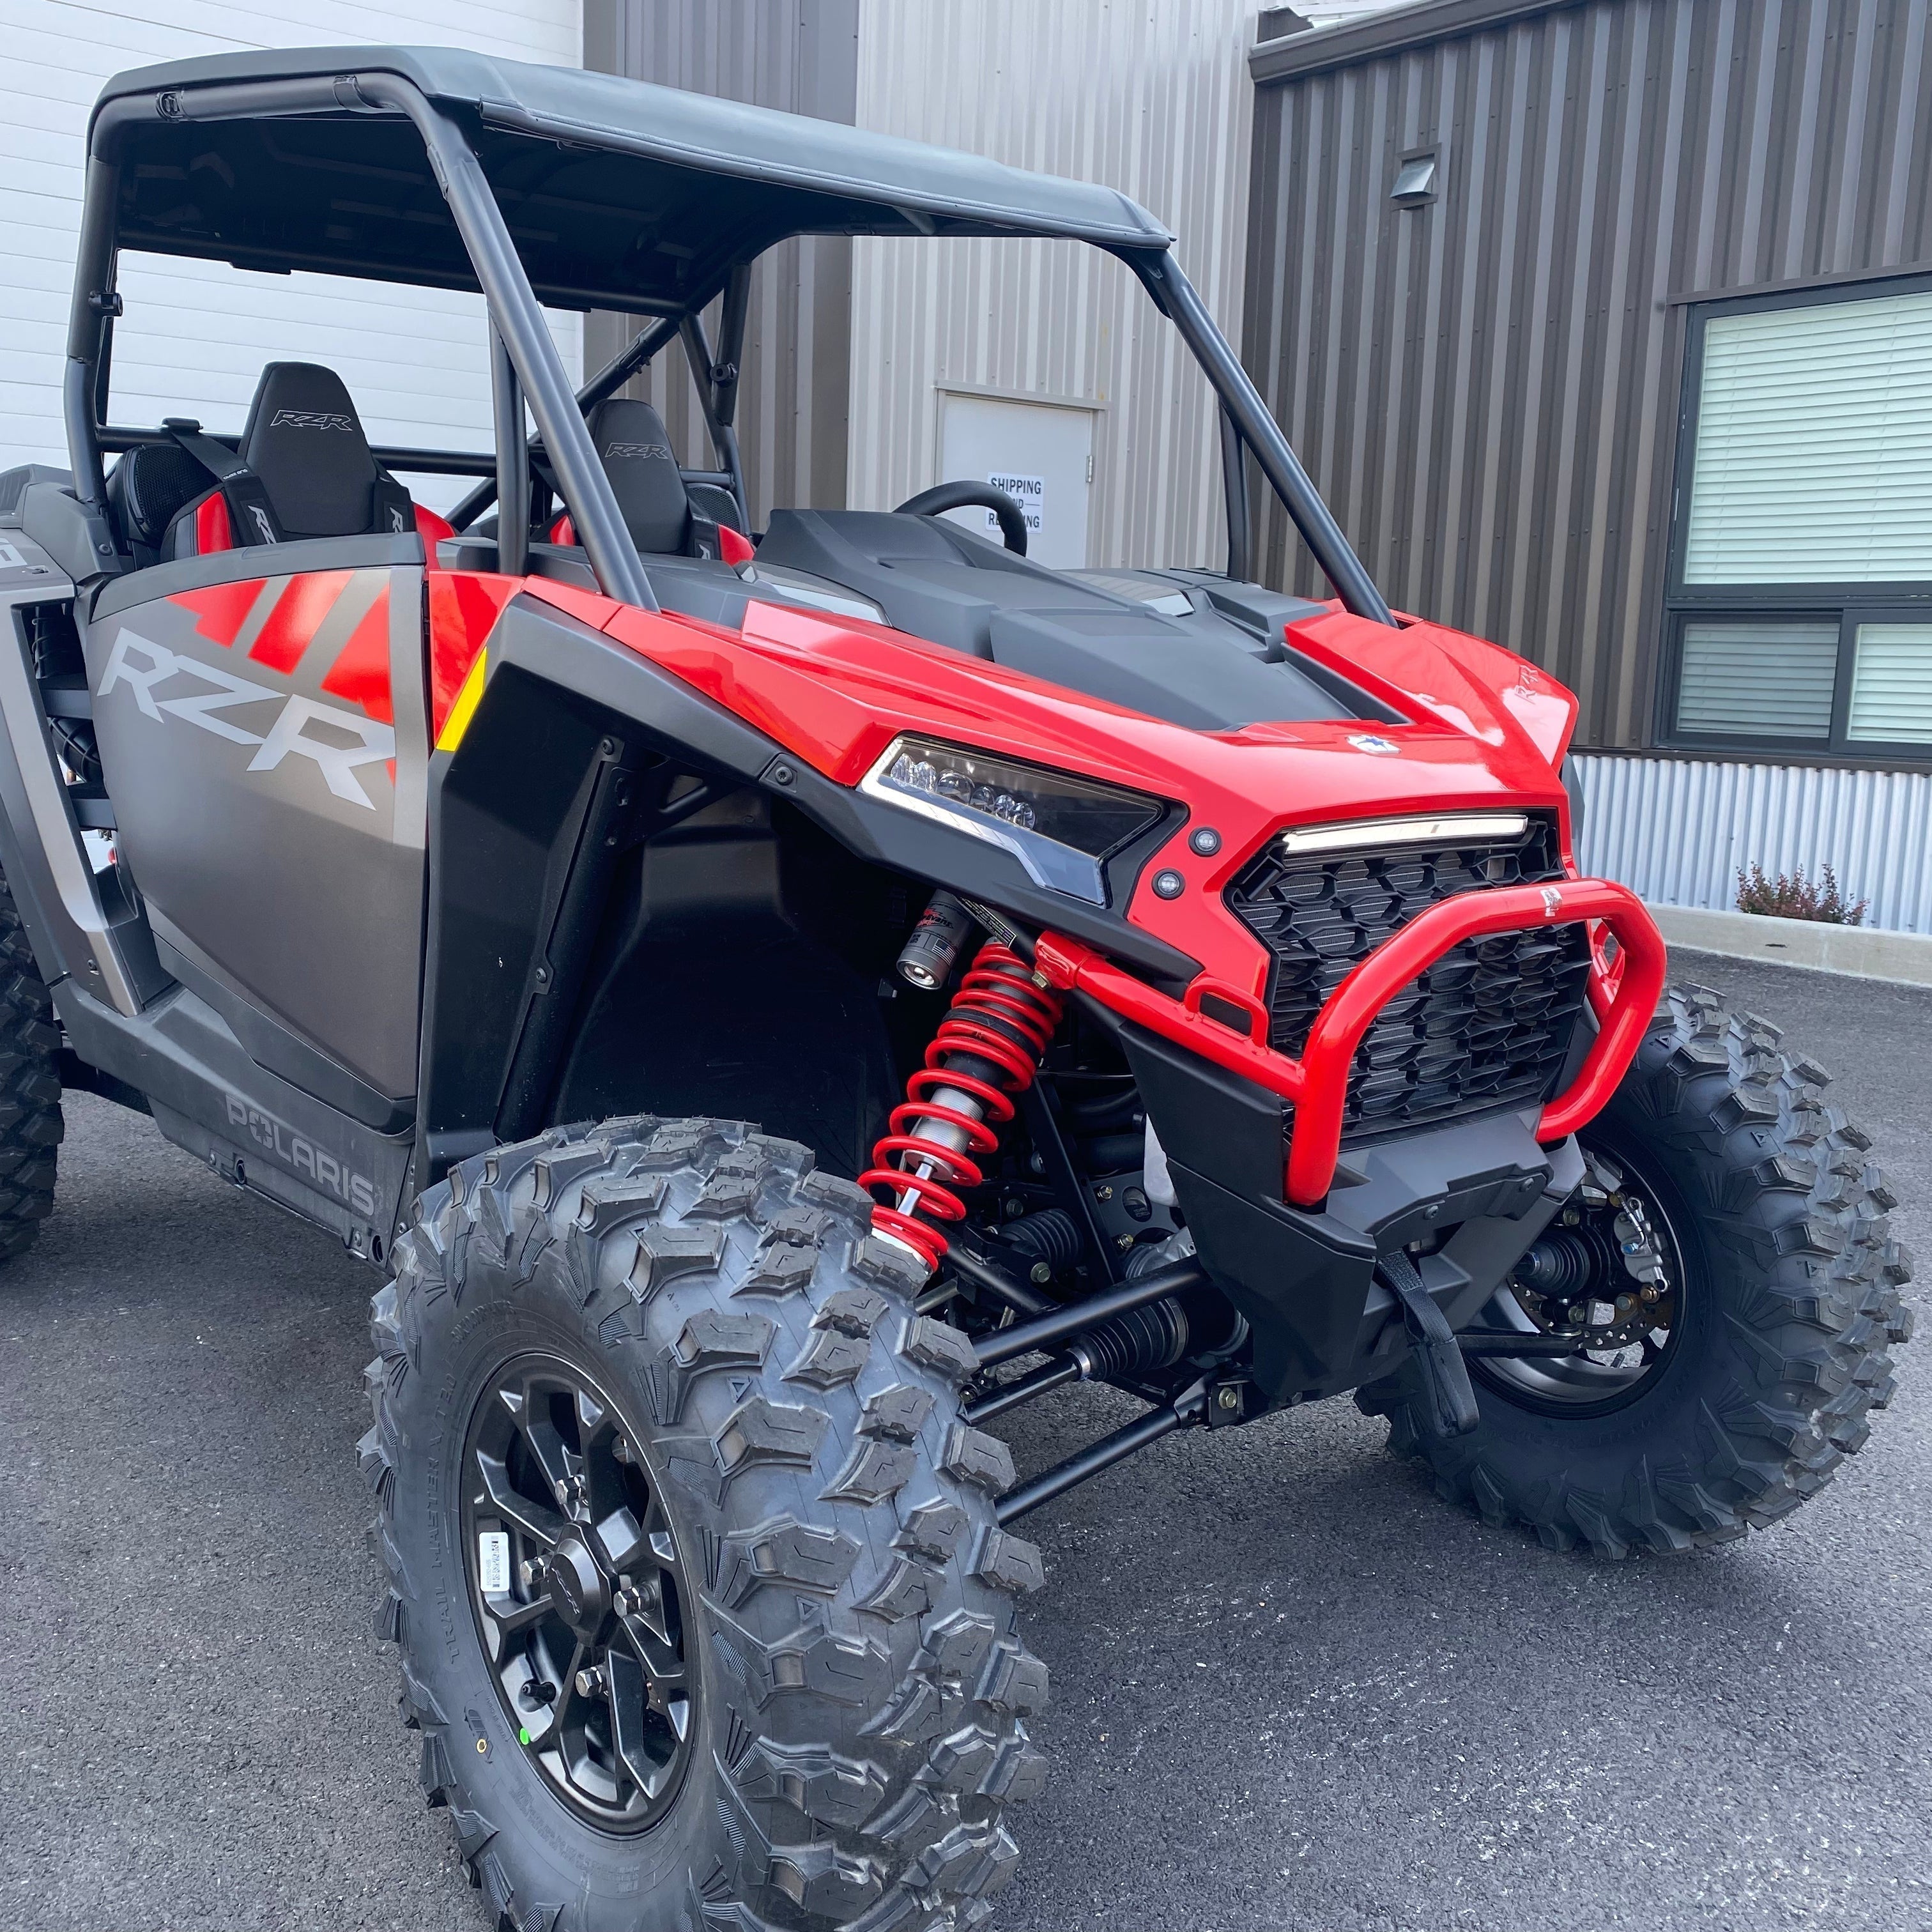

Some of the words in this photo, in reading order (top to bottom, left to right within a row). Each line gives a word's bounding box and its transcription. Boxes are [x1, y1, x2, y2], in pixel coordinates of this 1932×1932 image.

[271, 409, 353, 431] RZR
[605, 442, 668, 459] RZR
[991, 477, 1041, 494] SHIPPING
[1013, 498, 1023, 509] ND
[248, 505, 277, 544] RZ
[97, 627, 395, 811] RZR
[226, 1094, 374, 1216] POLARIS
[427, 1457, 442, 1568] MASTER
[434, 1577, 459, 1664] TRAIL
